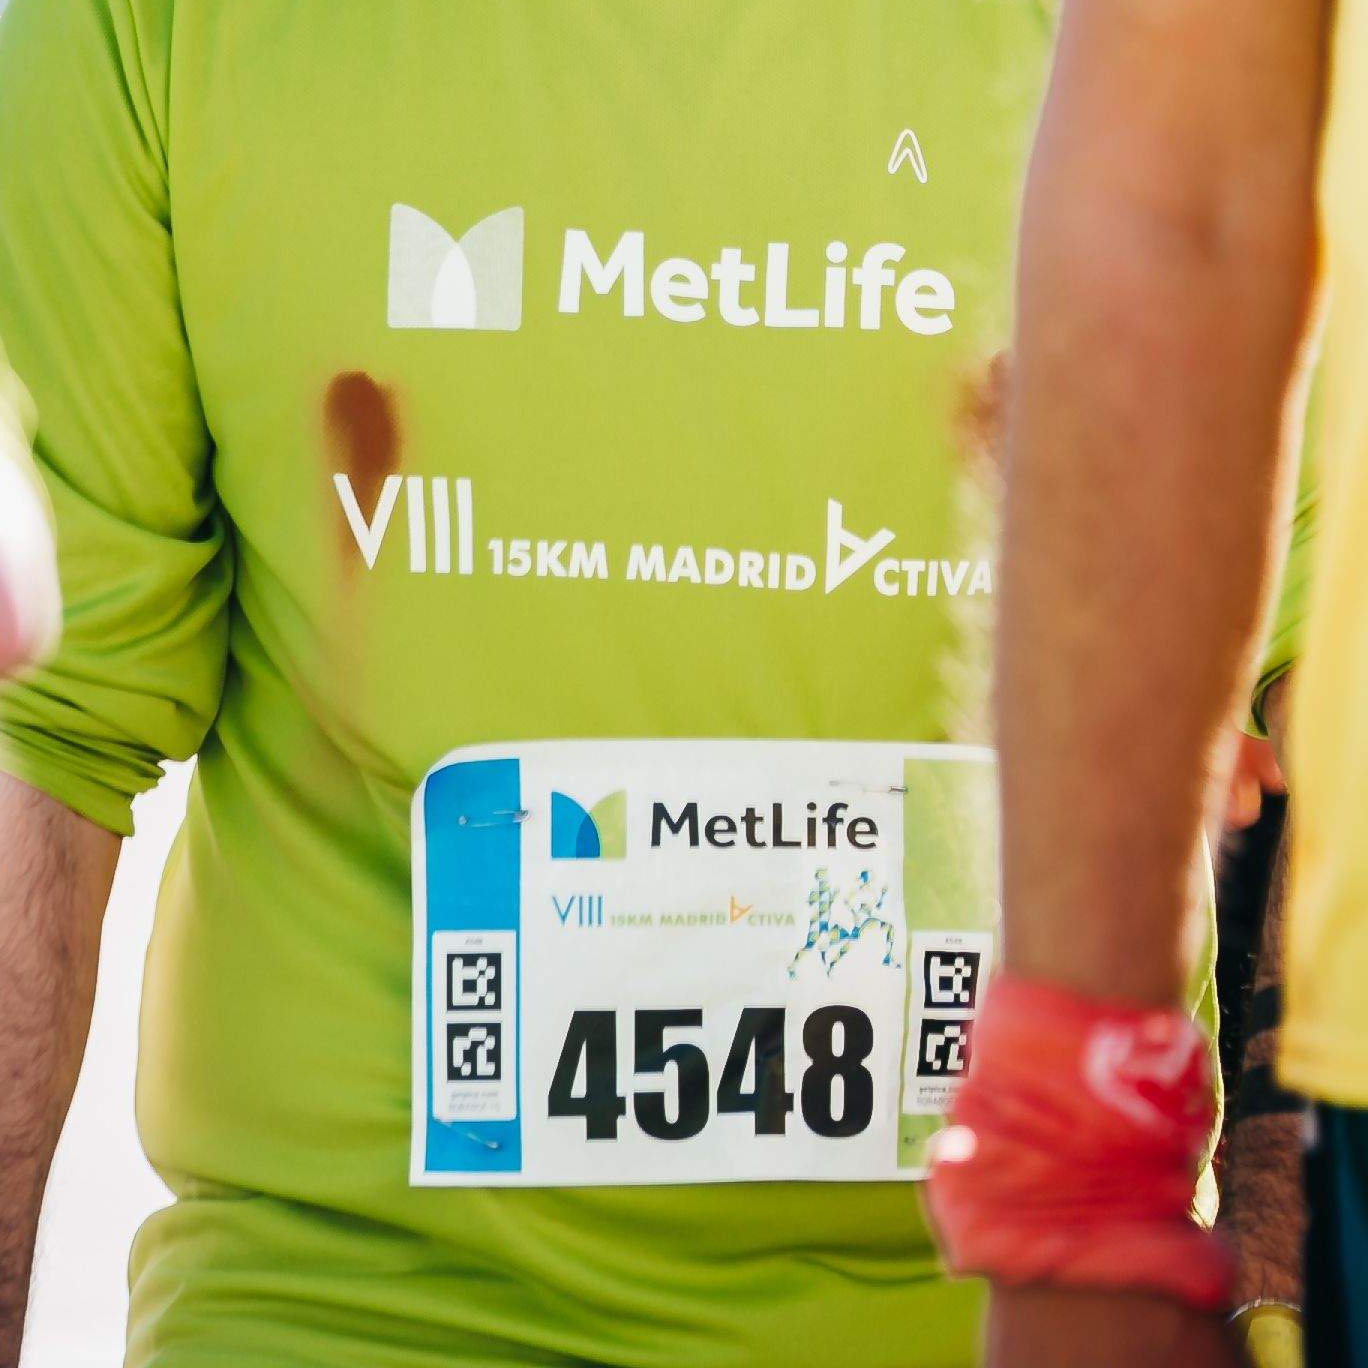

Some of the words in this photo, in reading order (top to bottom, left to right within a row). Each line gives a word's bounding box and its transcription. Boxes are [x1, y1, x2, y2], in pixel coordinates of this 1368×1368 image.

[558, 228, 956, 336] MetLife
[332, 472, 474, 575] VIII
[487, 537, 610, 580] 15KM
[649, 801, 880, 851] MetLife
[551, 894, 605, 927] VIII
[547, 1003, 876, 1142] 4548
